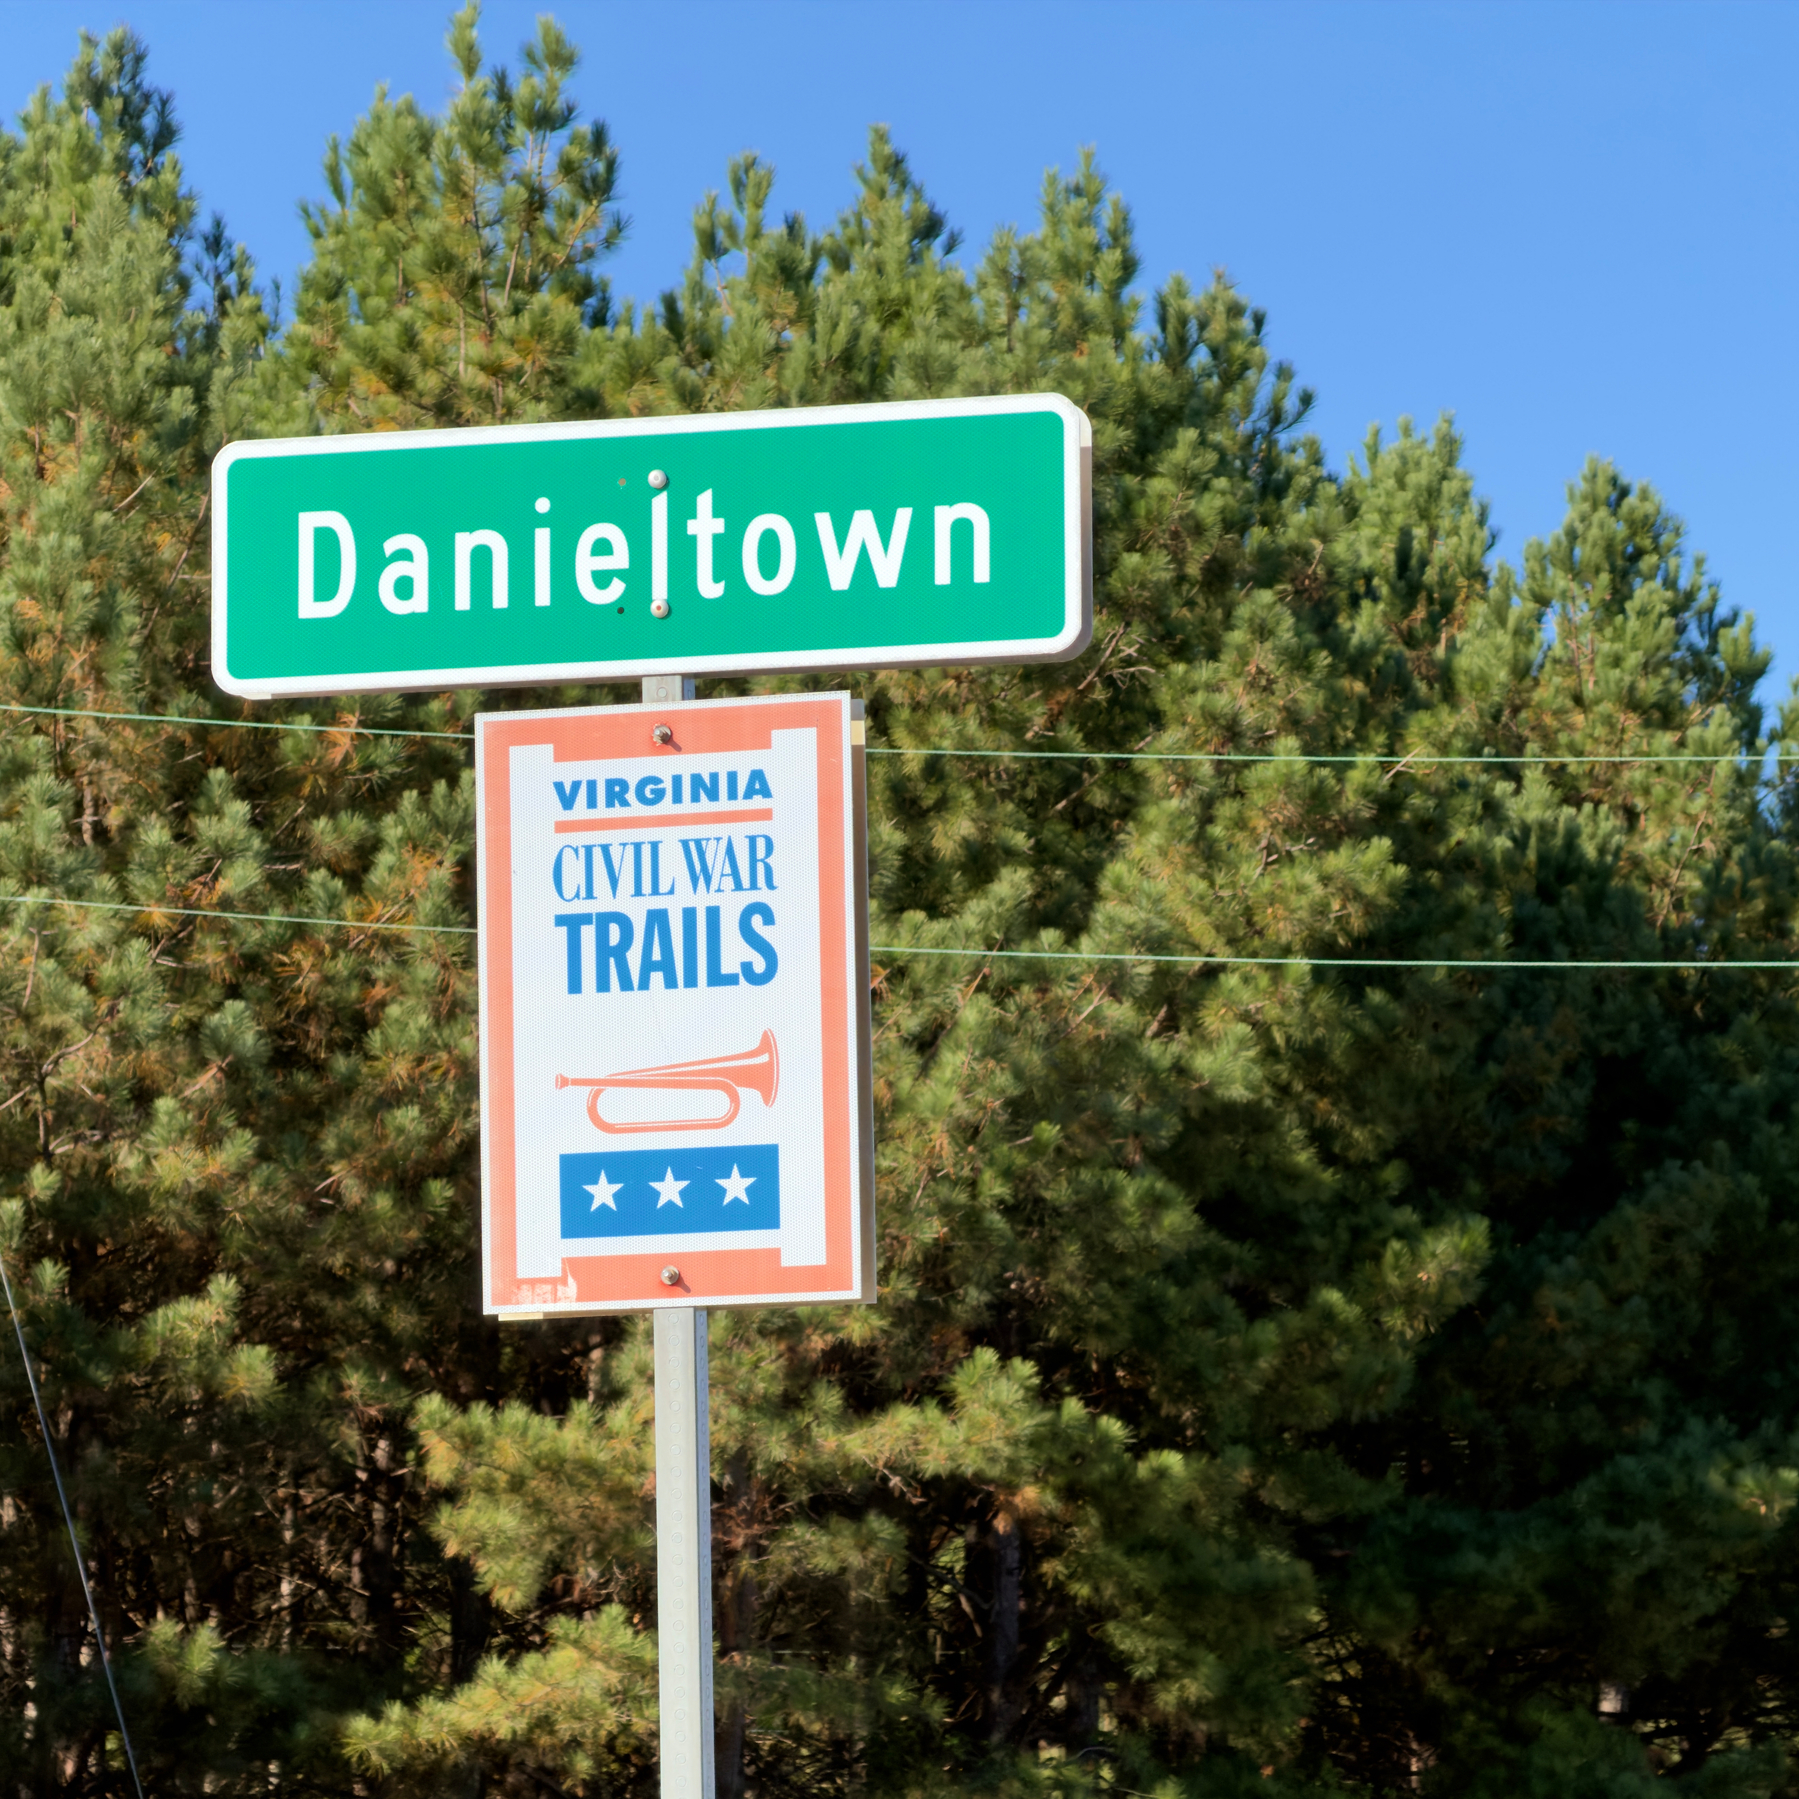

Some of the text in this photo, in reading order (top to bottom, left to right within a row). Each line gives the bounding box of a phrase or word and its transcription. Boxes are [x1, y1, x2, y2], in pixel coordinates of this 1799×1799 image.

[297, 488, 991, 619] Danieltown
[553, 769, 773, 811] VIRGINIA
[552, 834, 778, 902] CIVIL WAR
[554, 901, 779, 995] TRAILS
